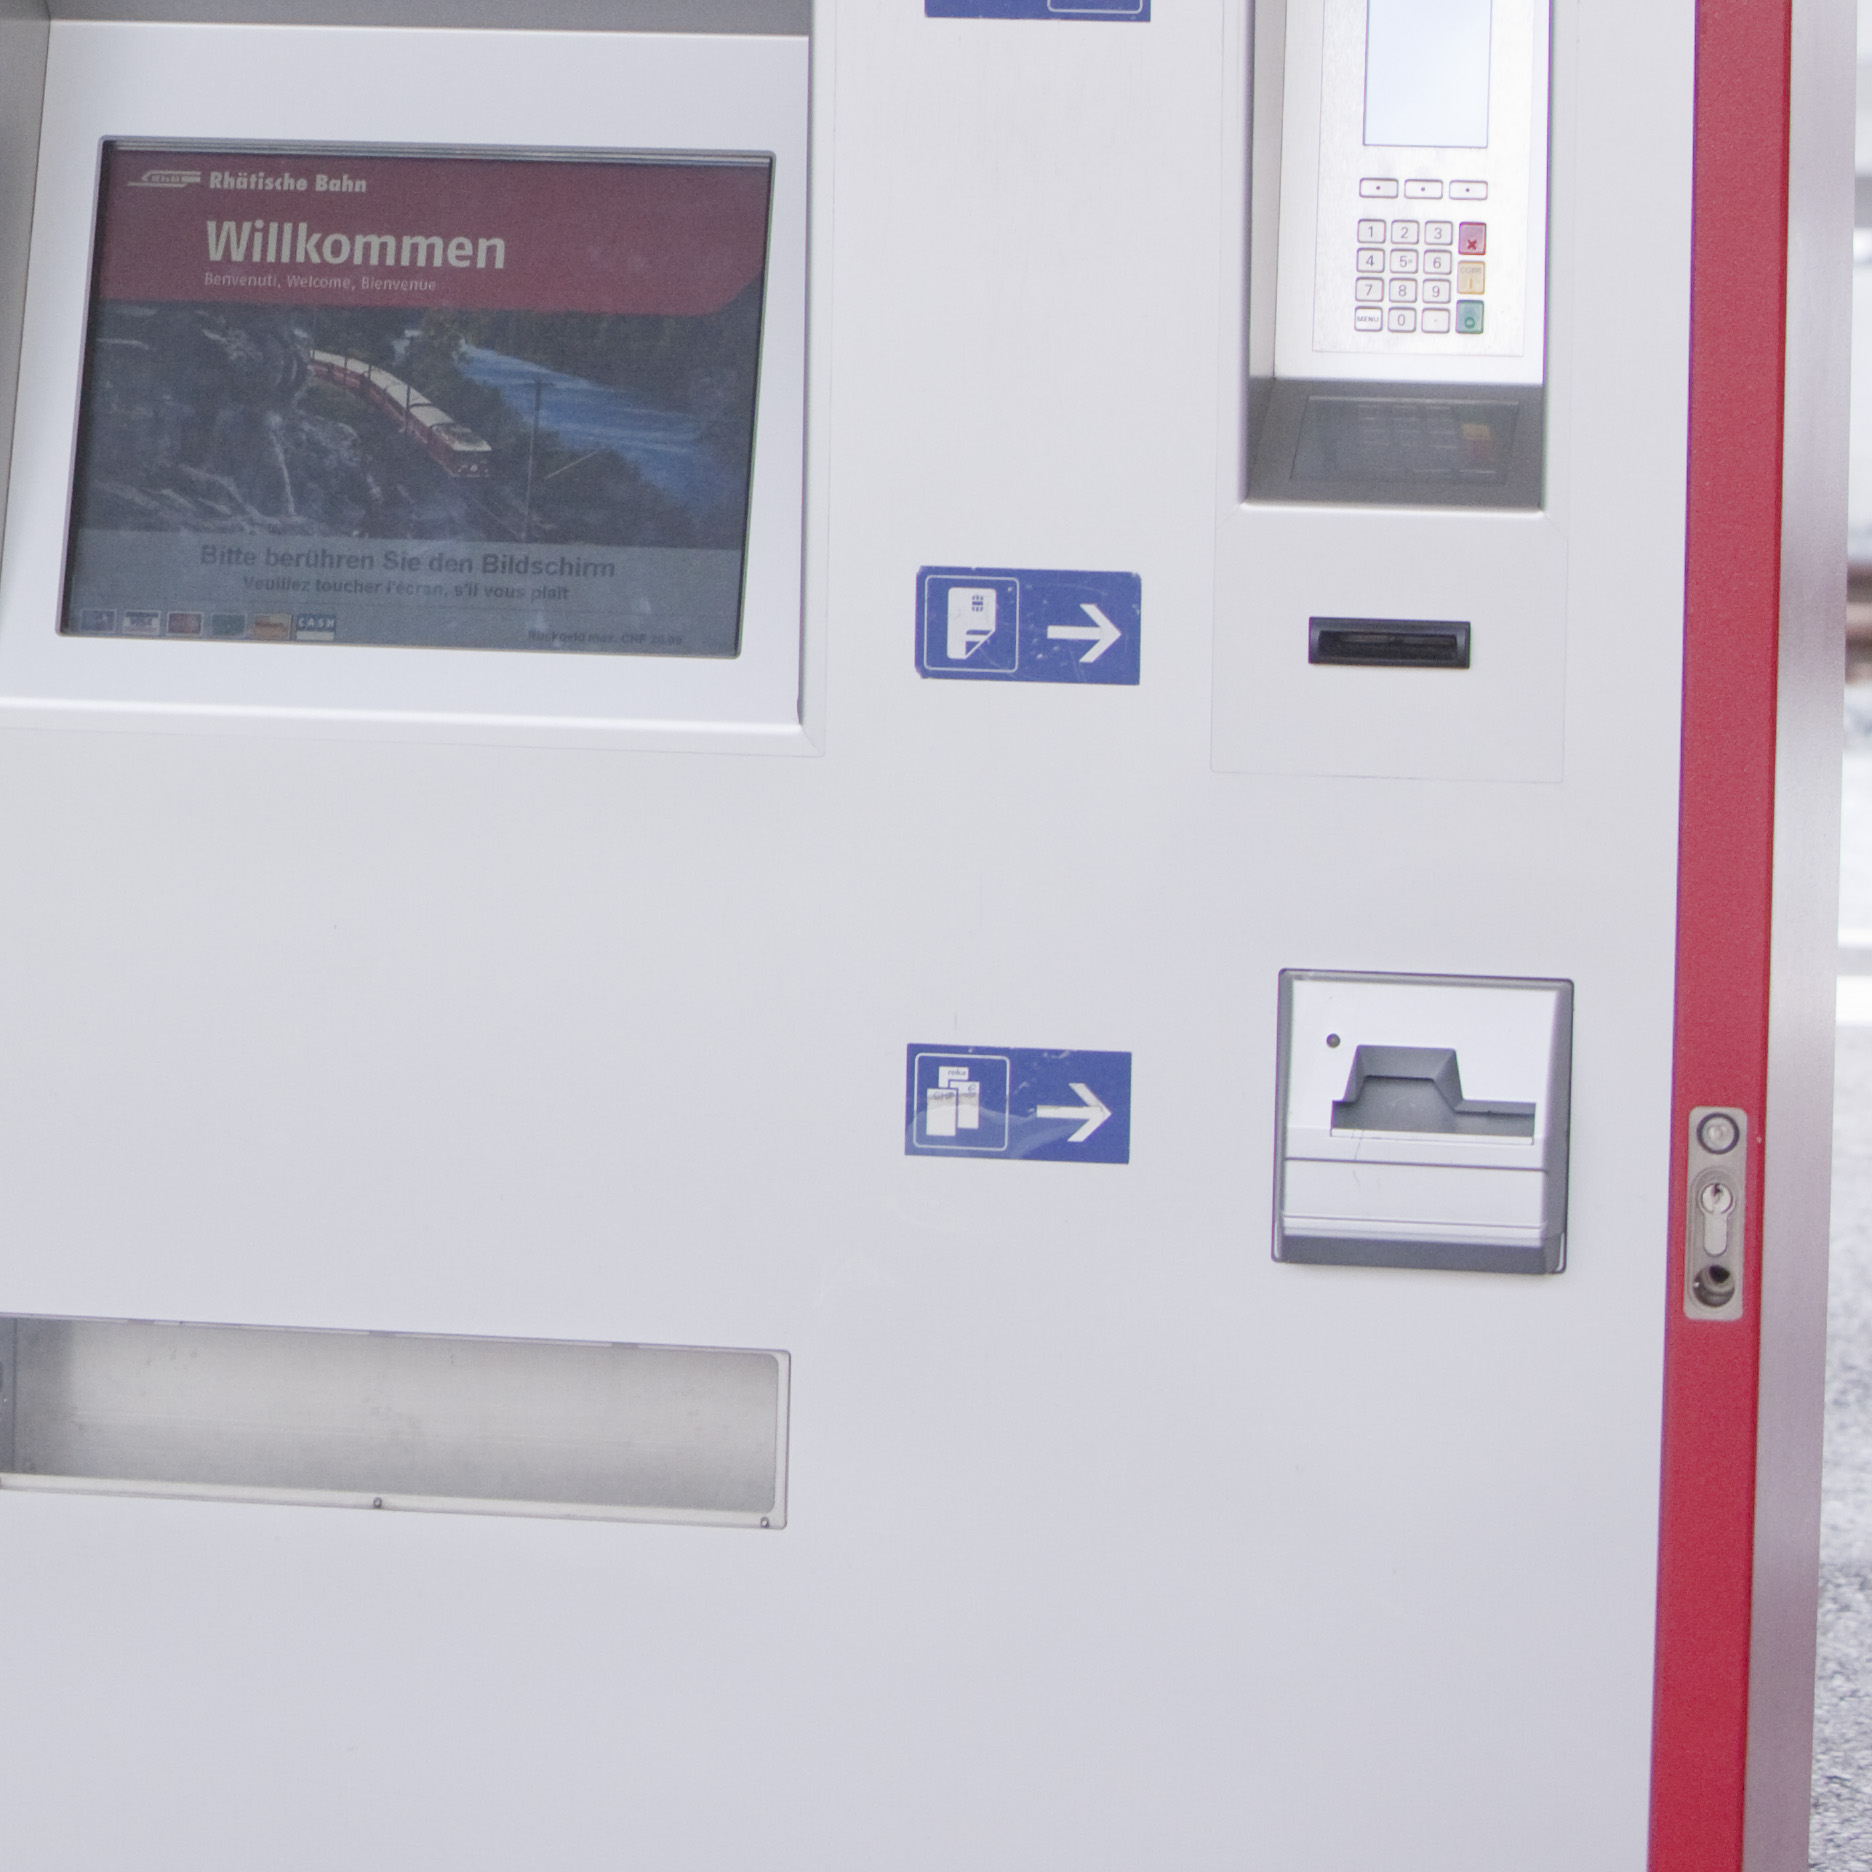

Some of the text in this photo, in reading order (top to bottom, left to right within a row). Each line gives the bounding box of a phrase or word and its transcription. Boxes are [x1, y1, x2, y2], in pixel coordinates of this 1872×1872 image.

[209, 171, 308, 192] Rhätische
[314, 173, 368, 193] Bahn
[1367, 225, 1443, 240] 1 2 3
[205, 219, 507, 270] Willkommen
[1365, 254, 1442, 269] 4 5 6
[360, 275, 437, 293] Bienvenue
[1364, 283, 1440, 298] 7 8 9
[1397, 313, 1406, 327] 0
[200, 544, 616, 579] Bitte berühren Sie den Bildschirm
[242, 575, 311, 596] Veuillez
[314, 577, 381, 596] toucher
[482, 585, 526, 600] vous
[296, 614, 337, 632] CASH
